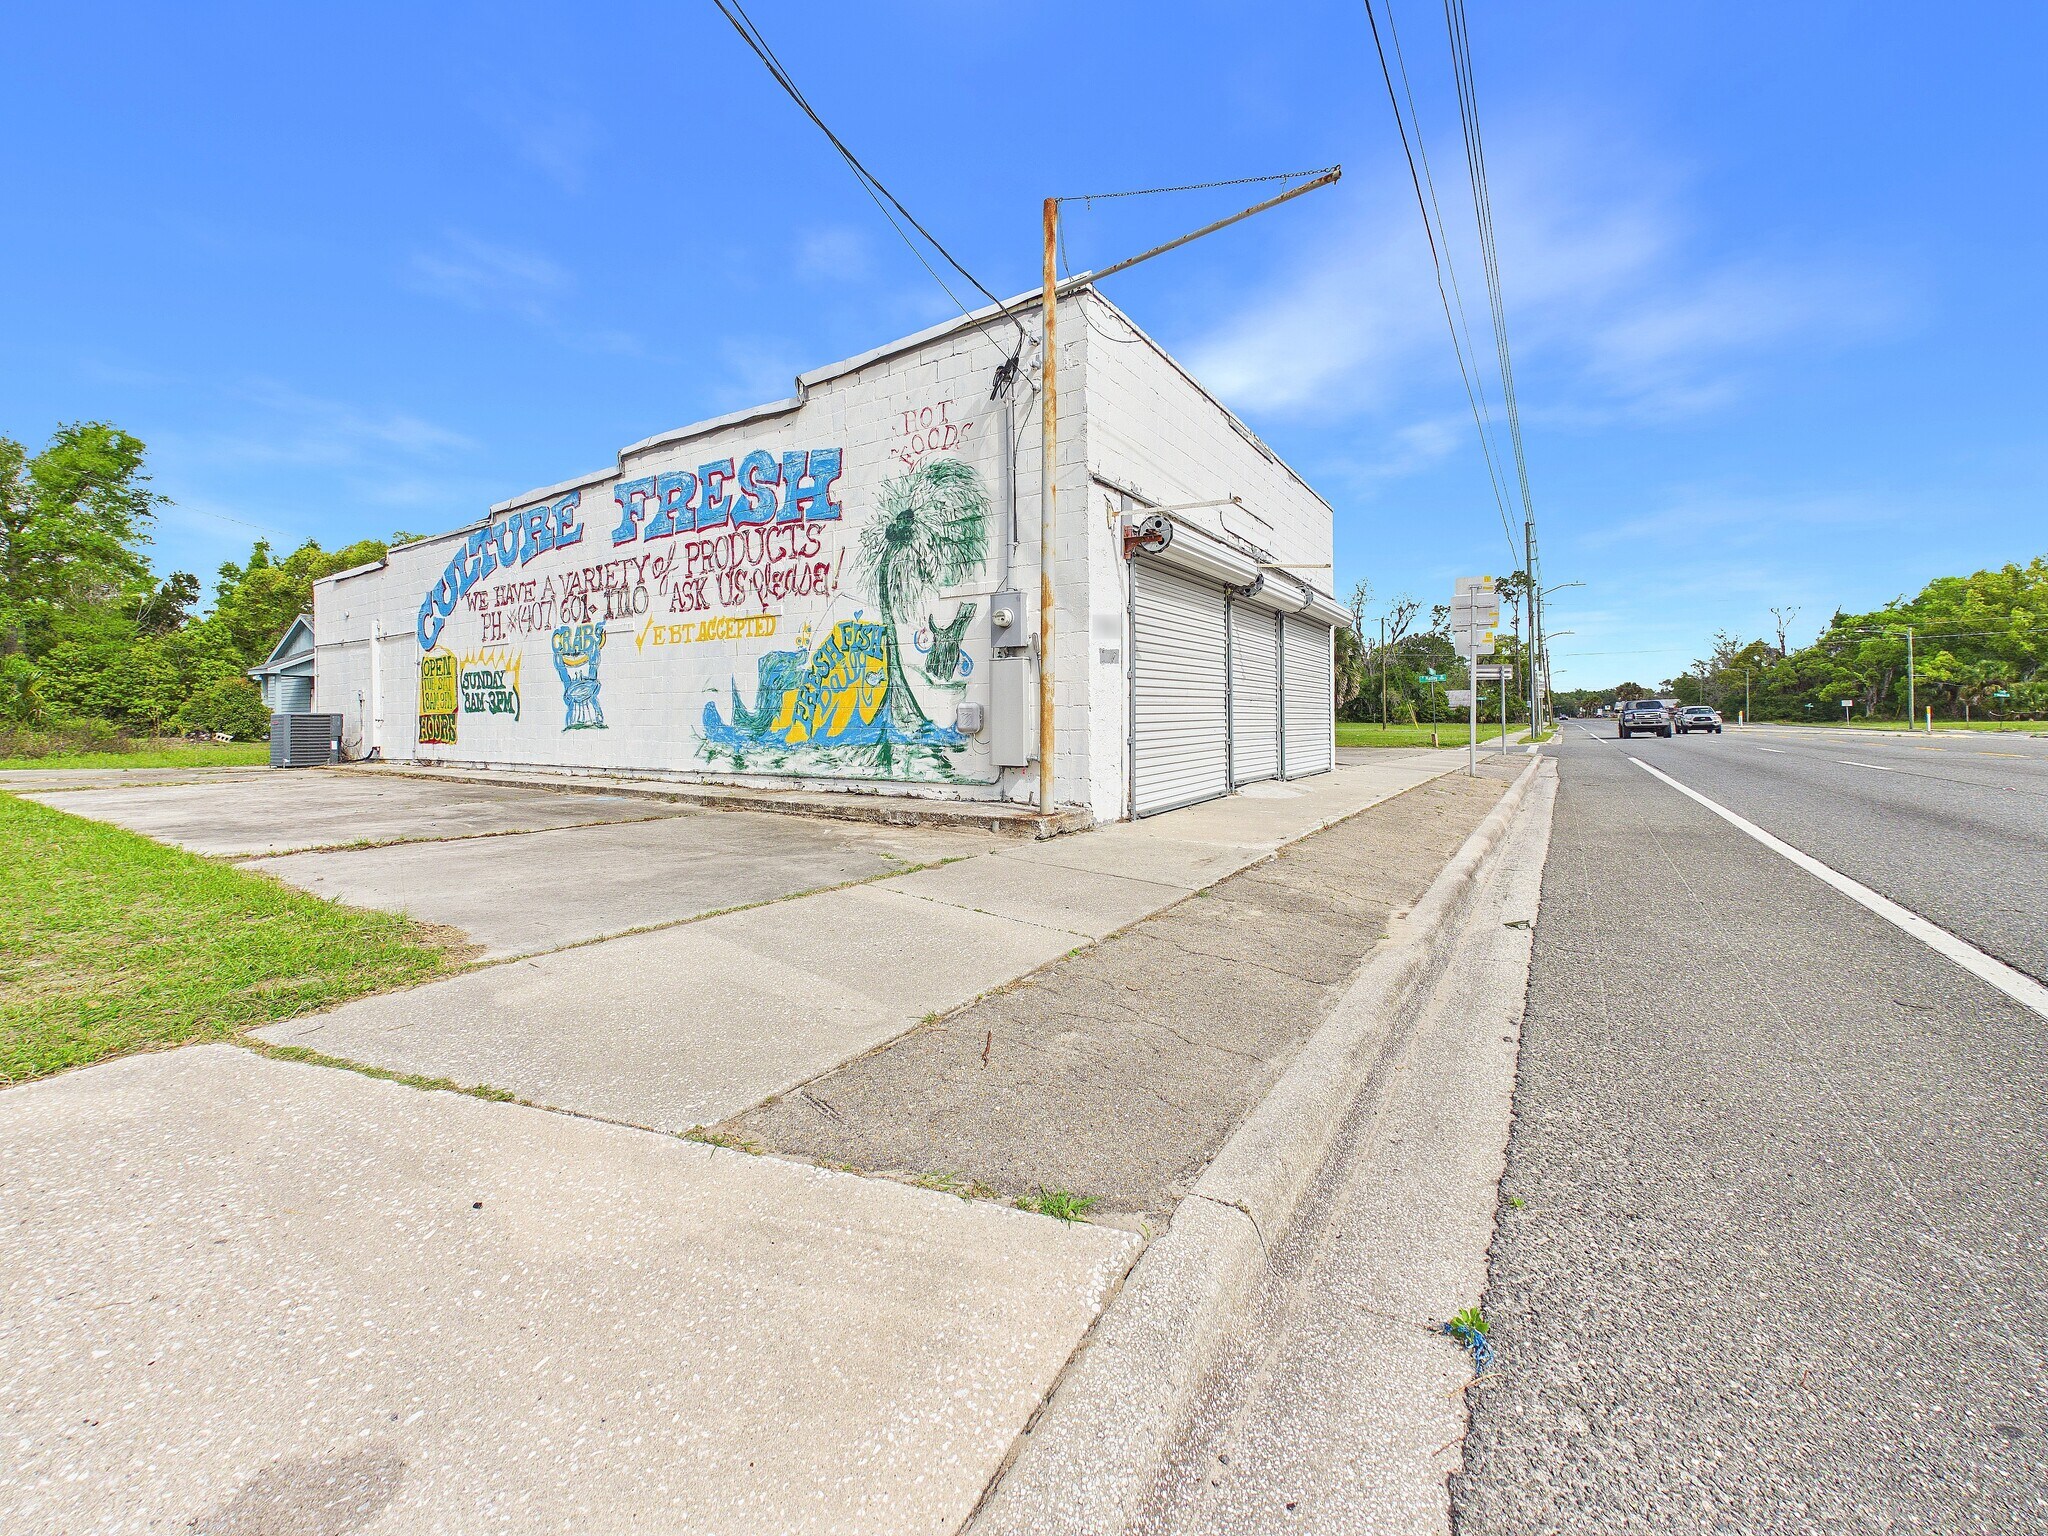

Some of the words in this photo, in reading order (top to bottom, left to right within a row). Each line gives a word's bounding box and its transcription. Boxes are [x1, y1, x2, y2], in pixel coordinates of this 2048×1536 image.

[901, 399, 954, 436] HOT
[417, 489, 584, 652] CULTURE
[611, 447, 843, 547] FRESH
[465, 591, 489, 612] WE
[493, 578, 536, 607] HAVE
[541, 575, 556, 602] A
[559, 553, 651, 598] VARIETY
[651, 540, 679, 597] of
[684, 523, 827, 578] PRODUCTS
[669, 575, 710, 613] ASK
[716, 566, 748, 606] US
[481, 611, 507, 642] PH.
[552, 619, 607, 653] CRABS
[695, 614, 778, 643] ACCEPTED
[838, 620, 888, 662] FISH
[422, 656, 452, 677] OPEN
[419, 714, 457, 741] HOURS
